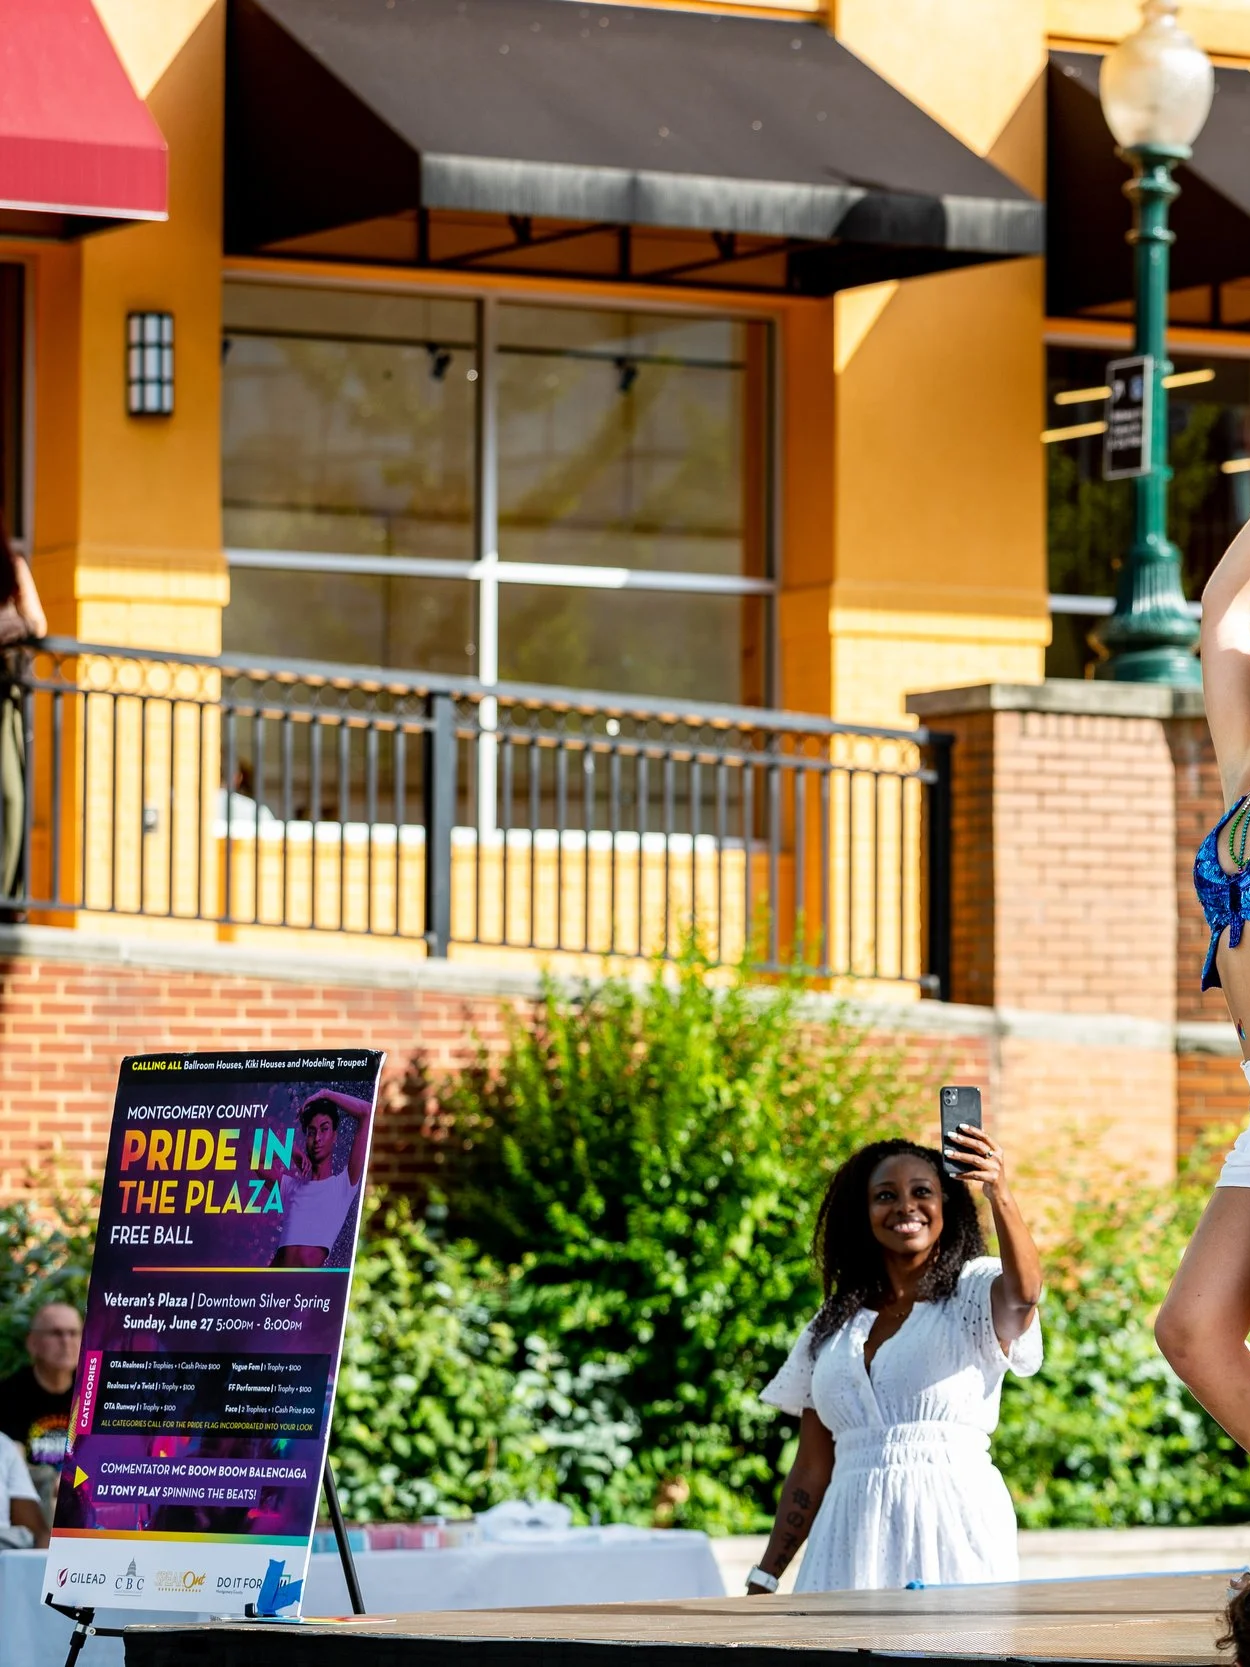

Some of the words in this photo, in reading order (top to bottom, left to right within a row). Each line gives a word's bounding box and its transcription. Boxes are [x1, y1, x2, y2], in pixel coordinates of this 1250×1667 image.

[132, 1062, 166, 1071] CALLING
[168, 1061, 182, 1070] ALL
[184, 1061, 215, 1070] Ballroom
[216, 1060, 244, 1070] Houses,
[245, 1060, 258, 1069] Kiki
[260, 1059, 285, 1069] Houses
[287, 1059, 300, 1068] and
[302, 1058, 335, 1069] Modeling
[337, 1057, 367, 1069] Troupes!
[127, 1106, 214, 1120] MONTGOMERY
[216, 1104, 268, 1118] COUNTY
[120, 1128, 240, 1171] PRIDE
[250, 1128, 295, 1170] IN
[118, 1180, 178, 1214] THE
[185, 1180, 284, 1214] PLAZA
[110, 1226, 150, 1244] FREE
[154, 1226, 193, 1244] BALL
[104, 1292, 154, 1307] Veteran's
[158, 1292, 187, 1307] Plaza
[198, 1293, 256, 1307] Downtown
[260, 1293, 290, 1307] Silver
[294, 1294, 330, 1312] Spring
[124, 1314, 166, 1332] Sunday,
[169, 1315, 197, 1329] June
[200, 1318, 213, 1329] 27
[216, 1318, 253, 1330] 5:00PM
[264, 1318, 302, 1330] 8:00PM
[153, 1362, 173, 1370] Trophies
[232, 1363, 247, 1372] Vogue
[268, 1364, 284, 1372] Trophy
[81, 1357, 97, 1427] CATEGORIES
[162, 1383, 178, 1391] Trophy
[278, 1385, 295, 1393] Trophy
[116, 1403, 136, 1412] Runway
[143, 1403, 160, 1412] Trophy
[101, 1463, 170, 1475] COMMENTATOR
[172, 1464, 186, 1475] MC
[188, 1465, 217, 1476] BOOM
[219, 1466, 247, 1477] BOOM
[249, 1466, 307, 1479] BALENCIAGA
[97, 1485, 109, 1495] DJ
[111, 1485, 135, 1496] TONY
[138, 1486, 160, 1497] PLAY
[162, 1487, 205, 1498] SPINNING
[208, 1488, 224, 1498] THE
[227, 1489, 257, 1500] BEATS!
[70, 1572, 106, 1584] GILEAD
[217, 1577, 231, 1588] DO
[233, 1578, 242, 1588] IT
[243, 1578, 262, 1588] FOR
